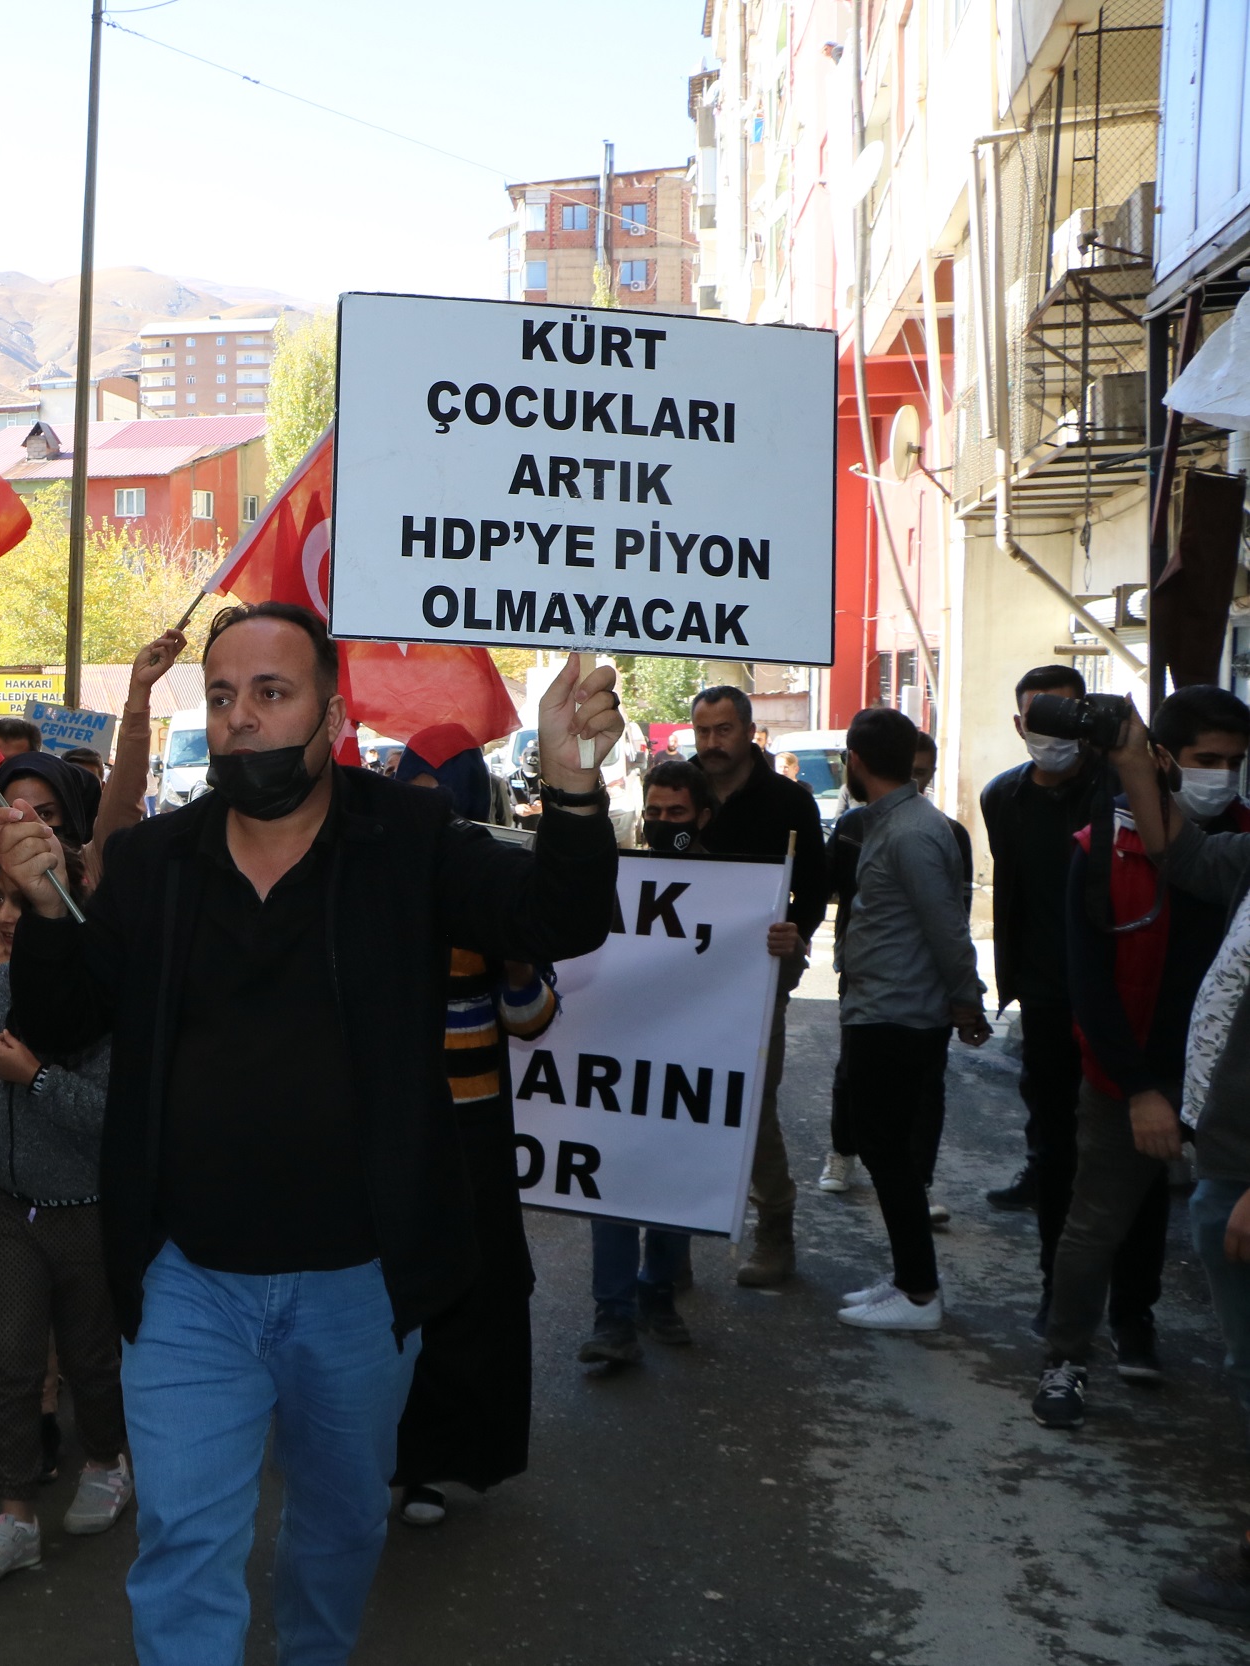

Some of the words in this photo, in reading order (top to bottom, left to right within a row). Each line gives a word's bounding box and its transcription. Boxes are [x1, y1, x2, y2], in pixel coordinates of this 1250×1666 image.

[521, 314, 667, 371] KÜRT
[427, 380, 736, 444] ÇOCUKLARI
[508, 454, 673, 506] ARTIK
[615, 520, 770, 581] PİYON
[422, 585, 750, 646] OLMAYACAK
[5, 678, 52, 689] HAKKARİ
[32, 703, 109, 731] BURHAN
[40, 722, 95, 743] CENTER
